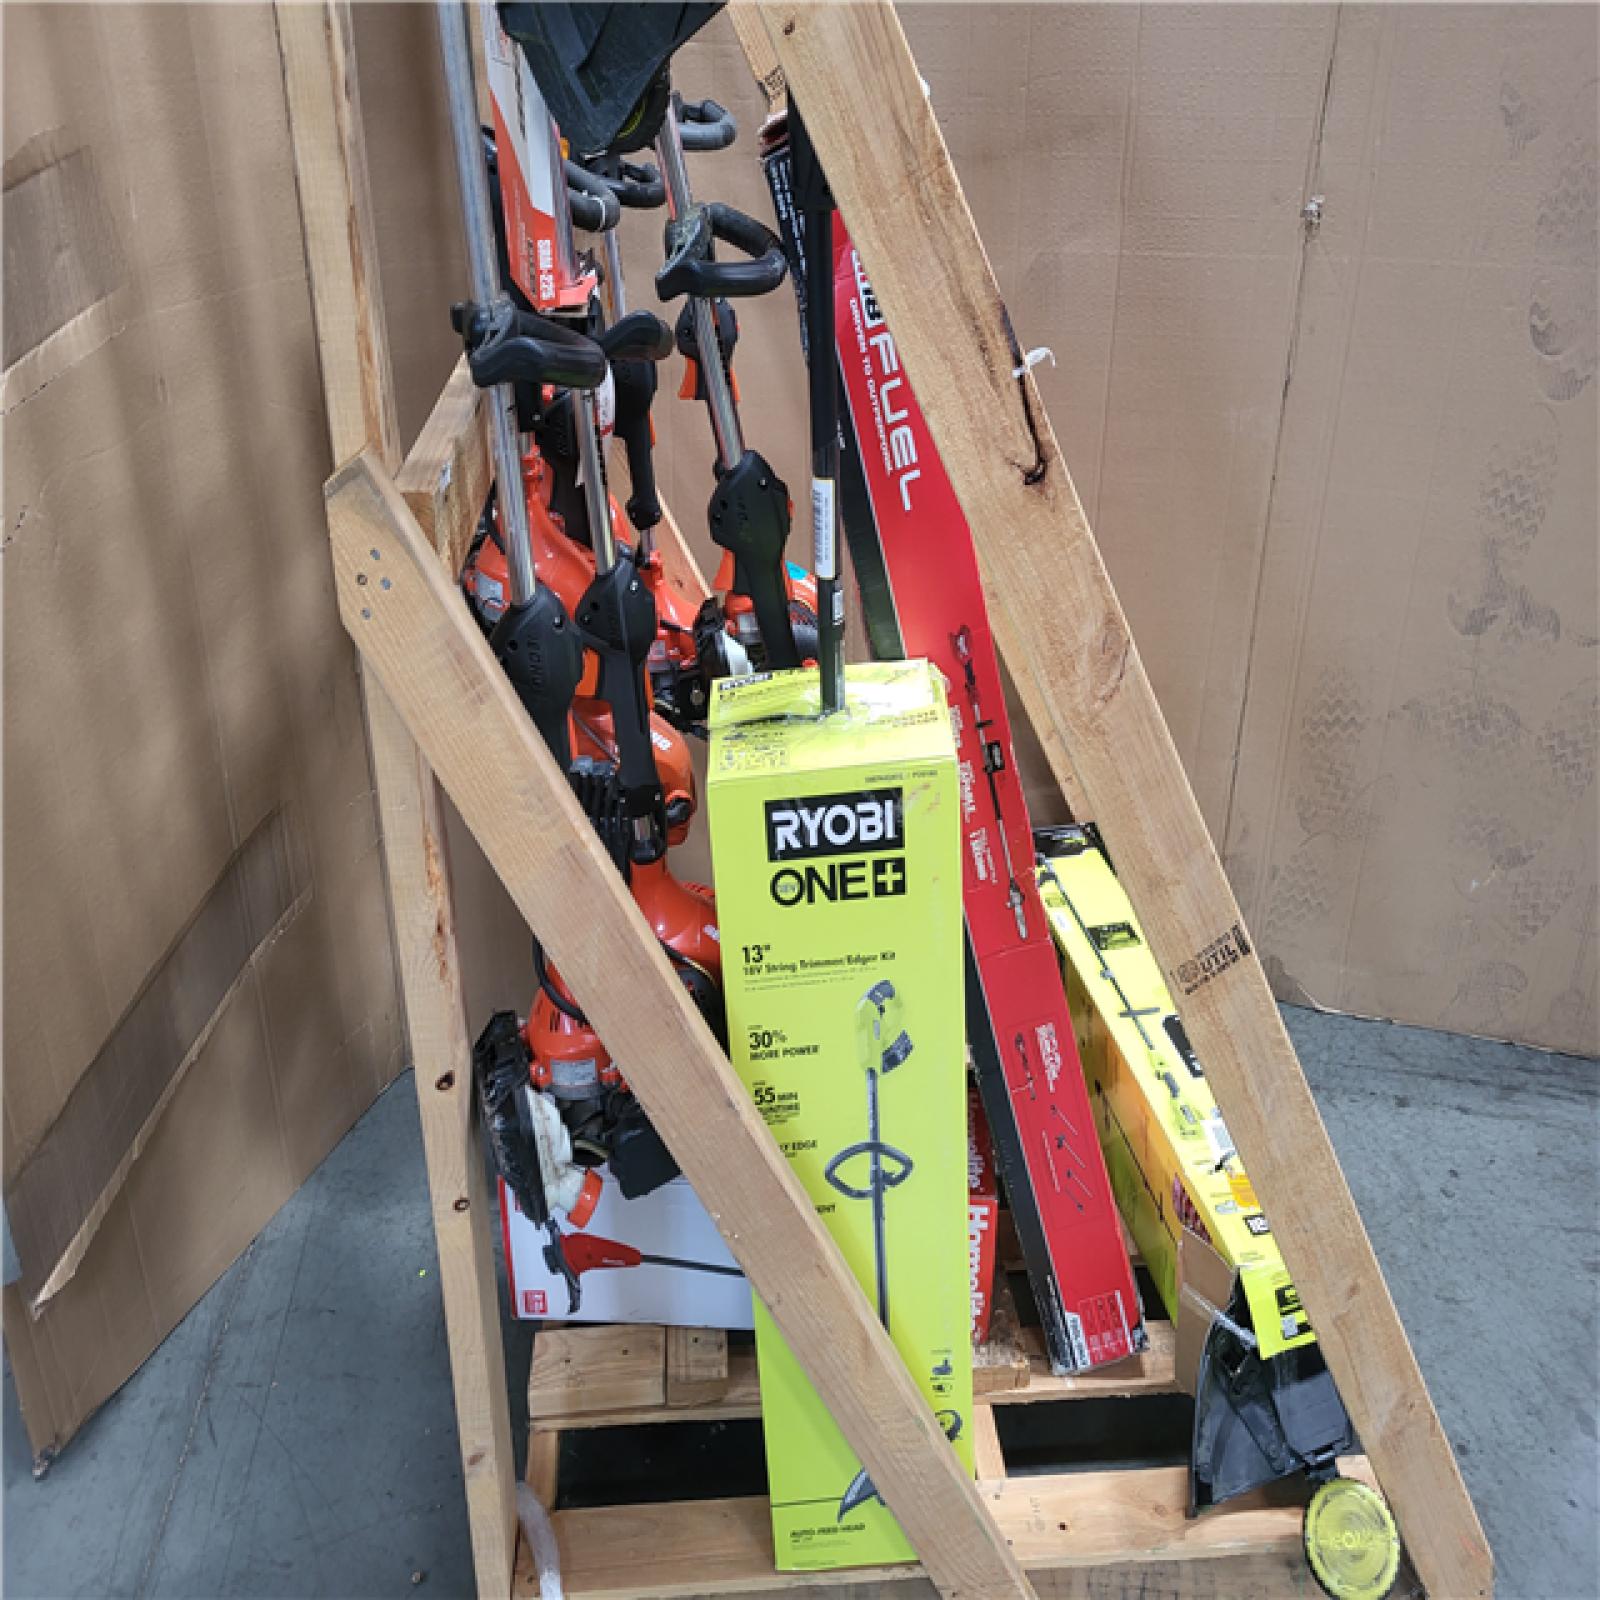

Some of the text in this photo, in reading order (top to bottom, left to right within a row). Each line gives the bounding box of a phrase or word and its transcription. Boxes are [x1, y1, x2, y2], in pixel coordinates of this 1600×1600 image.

[869, 332, 921, 512] FUEL
[771, 799, 898, 851] RYOBI
[742, 944, 771, 964] 13"
[749, 1029, 788, 1050] 30%
[754, 1086, 776, 1106] 55
